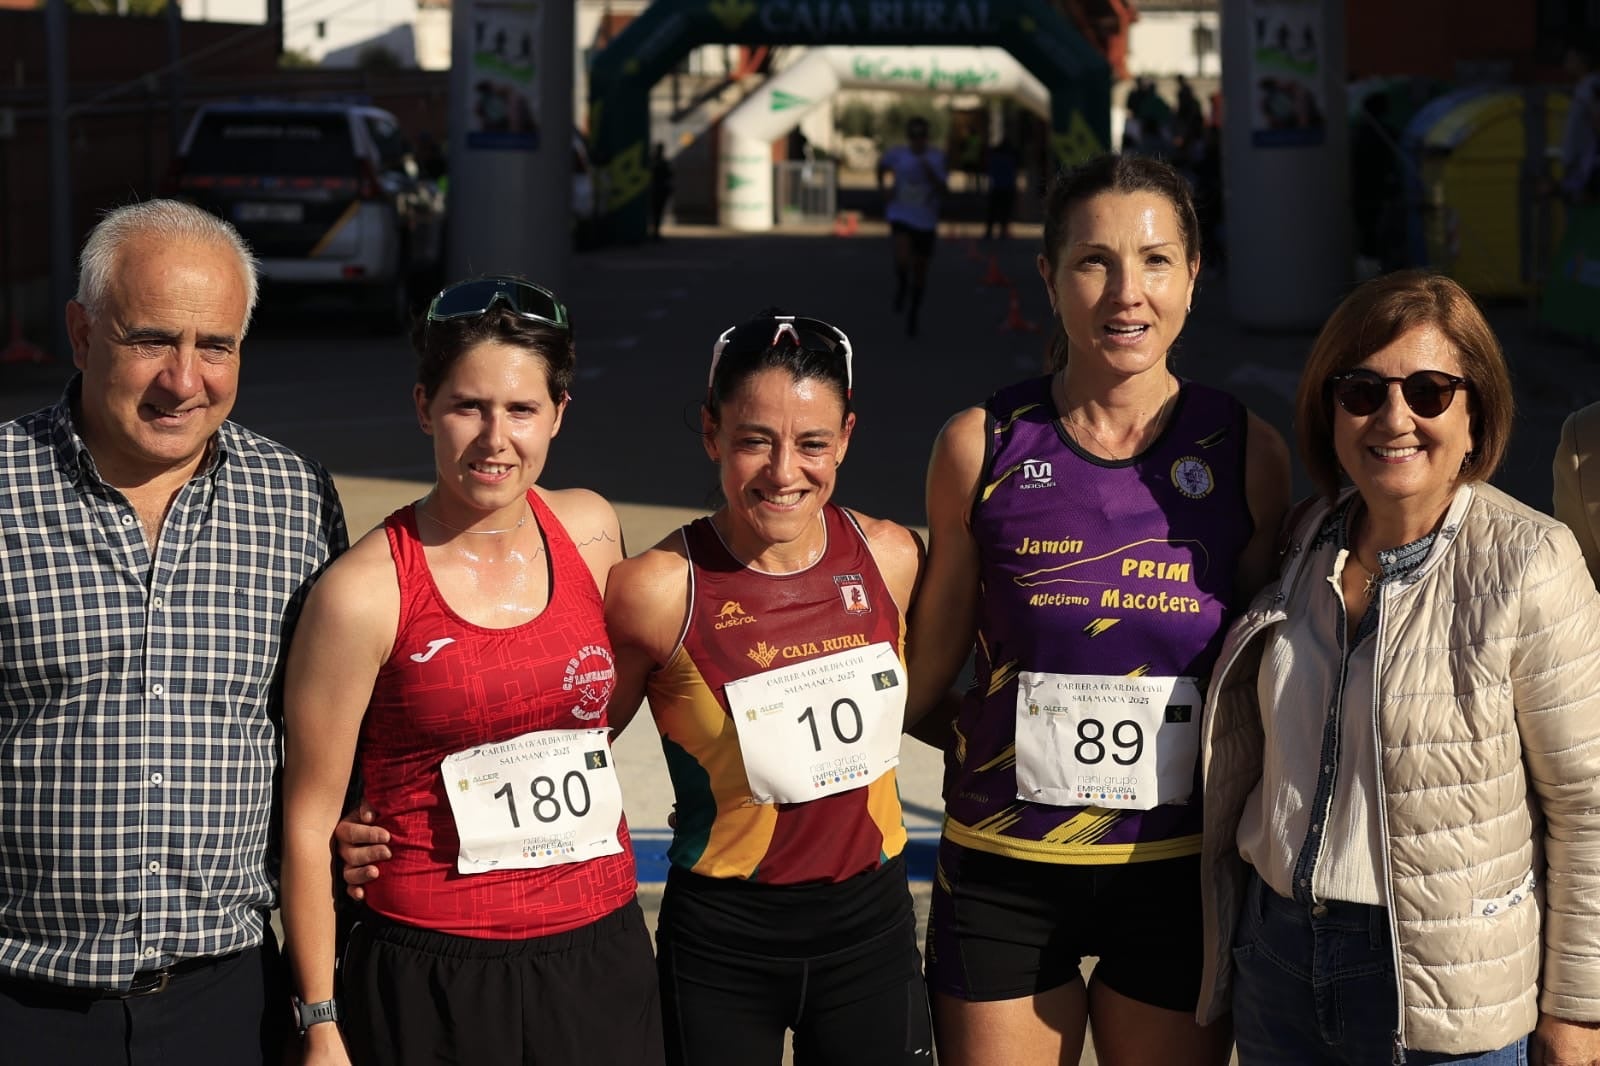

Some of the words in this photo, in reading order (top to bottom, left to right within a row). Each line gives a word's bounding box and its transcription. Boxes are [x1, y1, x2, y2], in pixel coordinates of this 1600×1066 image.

[1015, 536, 1083, 555] Jamón
[1121, 558, 1190, 582] PRIM
[1029, 593, 1090, 606] Atletismo
[1101, 589, 1200, 613] Macotera
[782, 643, 820, 659] CAJA
[822, 633, 870, 652] RURAL
[563, 658, 580, 691] CLUB
[766, 671, 806, 688] CARRERA
[784, 676, 834, 696] SALAMANCA
[837, 670, 856, 682] 2025
[1057, 682, 1099, 691] CARRERA
[1142, 684, 1163, 693] CIVIL
[1072, 694, 1125, 704] SALAMANCA
[1128, 696, 1149, 705] 2025
[797, 697, 864, 752] 10
[481, 742, 524, 757] CARRERA
[1074, 718, 1144, 765] 89
[500, 750, 551, 766] SALAMANCA
[553, 746, 570, 757] 2025
[812, 762, 868, 782] EMPRESARIAL
[494, 770, 591, 829] 180
[1077, 784, 1135, 793] EMPRESARIAL
